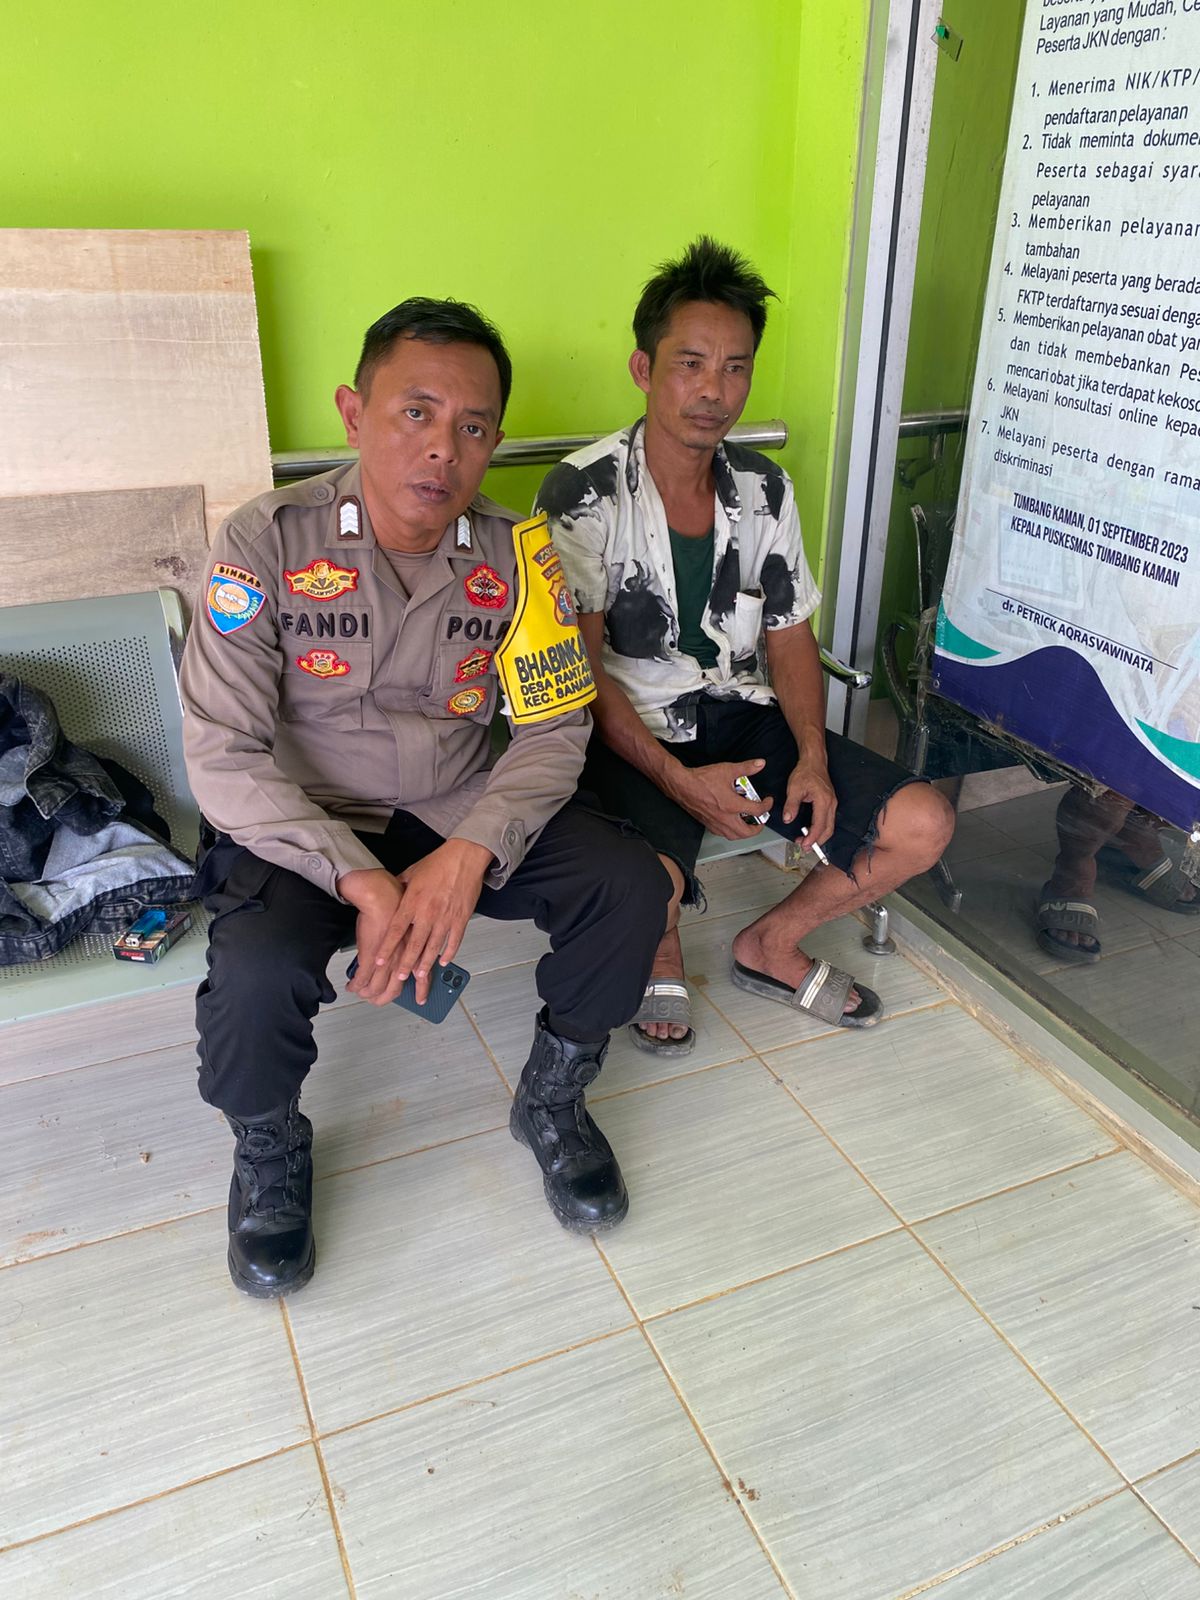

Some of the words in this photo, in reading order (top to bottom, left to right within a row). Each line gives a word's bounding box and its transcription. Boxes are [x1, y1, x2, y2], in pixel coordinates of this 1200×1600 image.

[1040, 11, 1090, 34] Layanan
[1093, 7, 1124, 28] yang
[1036, 35, 1080, 54] Peserta
[1083, 30, 1109, 49] JKN
[1031, 82, 1040, 97] 1.
[1048, 76, 1116, 96] Menerima
[1044, 107, 1117, 130] pendaftaran
[1119, 104, 1189, 126] pelayanan
[1023, 135, 1032, 150] 2.
[1042, 132, 1071, 149] Tidak
[1080, 132, 1134, 149] meminta
[1143, 129, 1200, 148] dokume
[1036, 162, 1087, 178] Peserta
[1096, 161, 1154, 183] sebagai
[1162, 163, 1200, 183] syar
[1032, 191, 1090, 210] pelayanan
[1011, 213, 1021, 228] 3.
[1028, 213, 1111, 233] Memberikan
[1026, 241, 1080, 260] tambahan
[1004, 262, 1013, 276] 4.
[1020, 263, 1070, 283] Melayani
[1072, 268, 1117, 287] peserta
[1120, 273, 1151, 293] yang
[1155, 273, 1200, 295] berada
[1017, 289, 1045, 306] FKTP
[1046, 293, 1118, 317] terdaftarnya
[1120, 304, 1161, 320] sesuai
[997, 308, 1006, 323] 5.
[1013, 310, 1080, 334] Memberikan
[1082, 320, 1144, 343] pelayanan
[1147, 328, 1178, 347] obat
[1010, 336, 1030, 352] dan
[1038, 340, 1067, 359] tidak
[1075, 349, 1170, 376] membebankan
[1006, 363, 1049, 383] mencari
[1050, 371, 1076, 388] obat
[1076, 374, 1099, 393] jika
[1101, 378, 1155, 404] terdapat
[987, 377, 996, 392] 6.
[1003, 382, 1049, 404] Melayani
[1054, 395, 1112, 418] konsultasi
[1118, 407, 1158, 427] online
[1165, 414, 1200, 437] kepa
[1000, 405, 1019, 422] JKN
[981, 421, 990, 435] 7.
[997, 425, 1046, 449] Melayani
[1052, 441, 1098, 463] peserta
[1106, 453, 1155, 479] dengan
[1164, 470, 1200, 491] rama
[994, 449, 1053, 477] diskriminasi
[1013, 492, 1052, 519] TUMBANG
[1052, 506, 1085, 532] KAMAN,
[1088, 516, 1101, 534] 01
[1101, 521, 1160, 554] SEPTEMBER
[1160, 540, 1189, 564] 2023
[1010, 515, 1041, 539] KEPALA
[1043, 527, 1094, 558] PUSKESMAS
[1096, 544, 1141, 574] TUMBANG
[1142, 561, 1180, 588] KAMAN
[219, 566, 261, 588] BINMAS
[280, 612, 369, 638] FANDI
[1002, 600, 1015, 614] dr.
[1017, 604, 1057, 633] PETRICK
[1058, 621, 1154, 674] AQRASVAWINATA
[520, 678, 554, 697] DESA
[523, 692, 554, 710] KEC.
